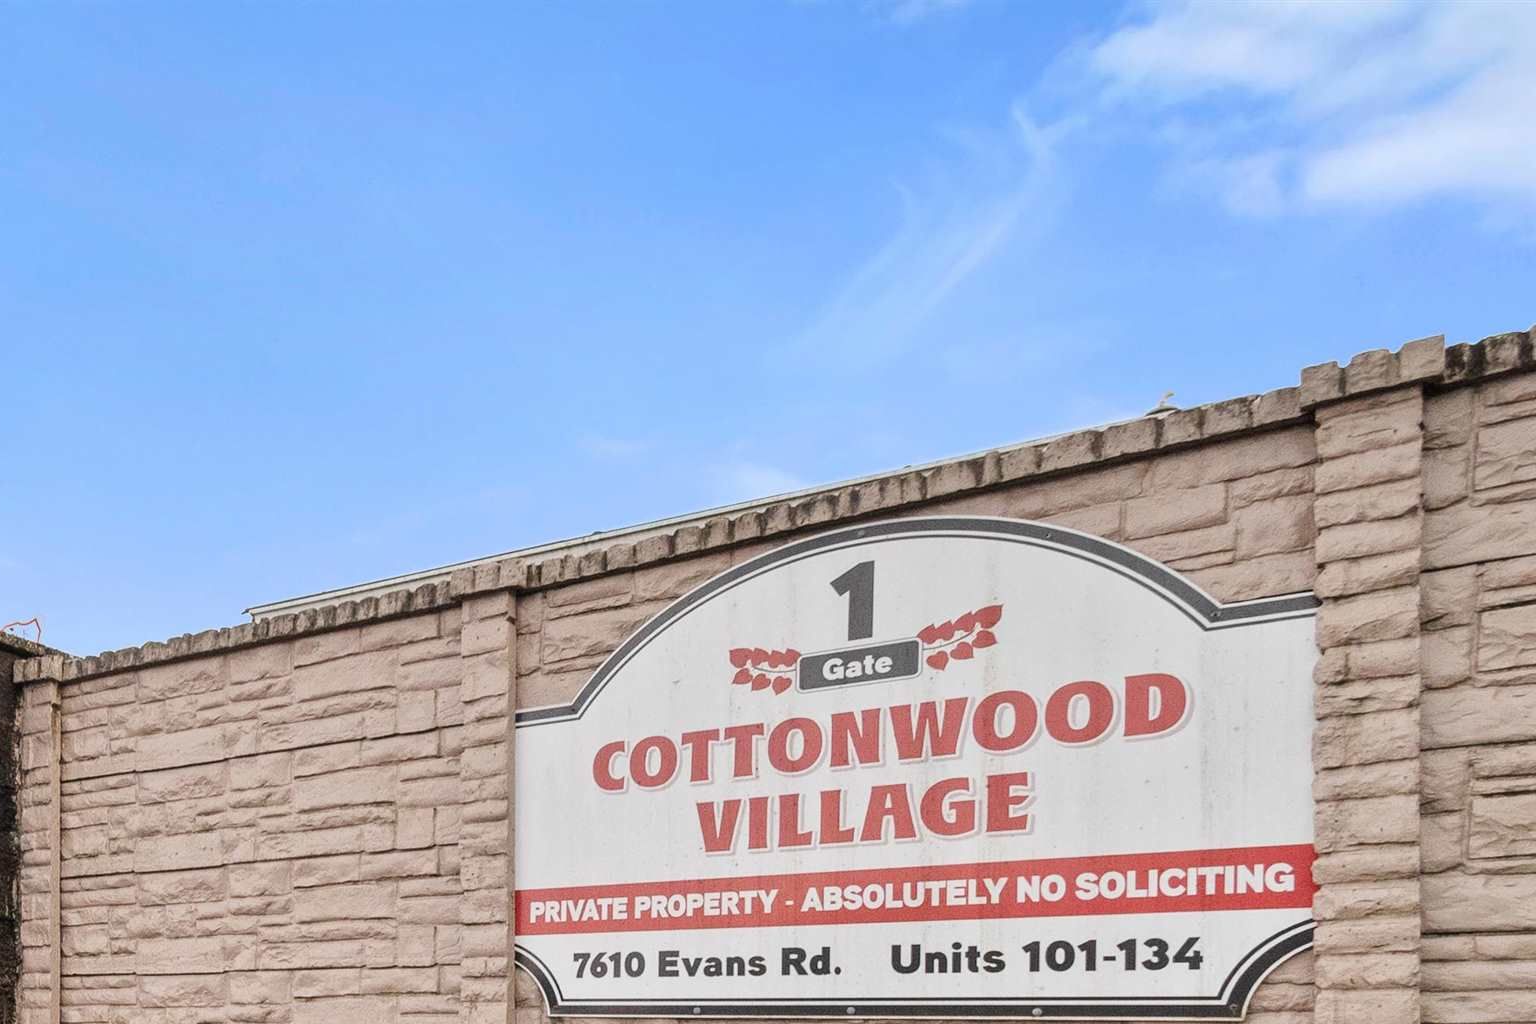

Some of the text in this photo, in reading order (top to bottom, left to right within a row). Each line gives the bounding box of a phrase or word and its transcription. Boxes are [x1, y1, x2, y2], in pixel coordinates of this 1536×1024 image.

[830, 560, 875, 641] 1
[821, 651, 894, 682] Gate
[592, 671, 1188, 792] COTTONWOOD
[696, 771, 1030, 853] VILLAGE
[529, 896, 629, 923] PRIVATE
[634, 888, 779, 919] PROPERTY
[800, 877, 1009, 912] ABSOLUTELY
[1015, 873, 1067, 903] NO
[1074, 863, 1295, 899] SOLICITING
[573, 936, 1204, 979] 7610 Evans Rd. Units 101-134
